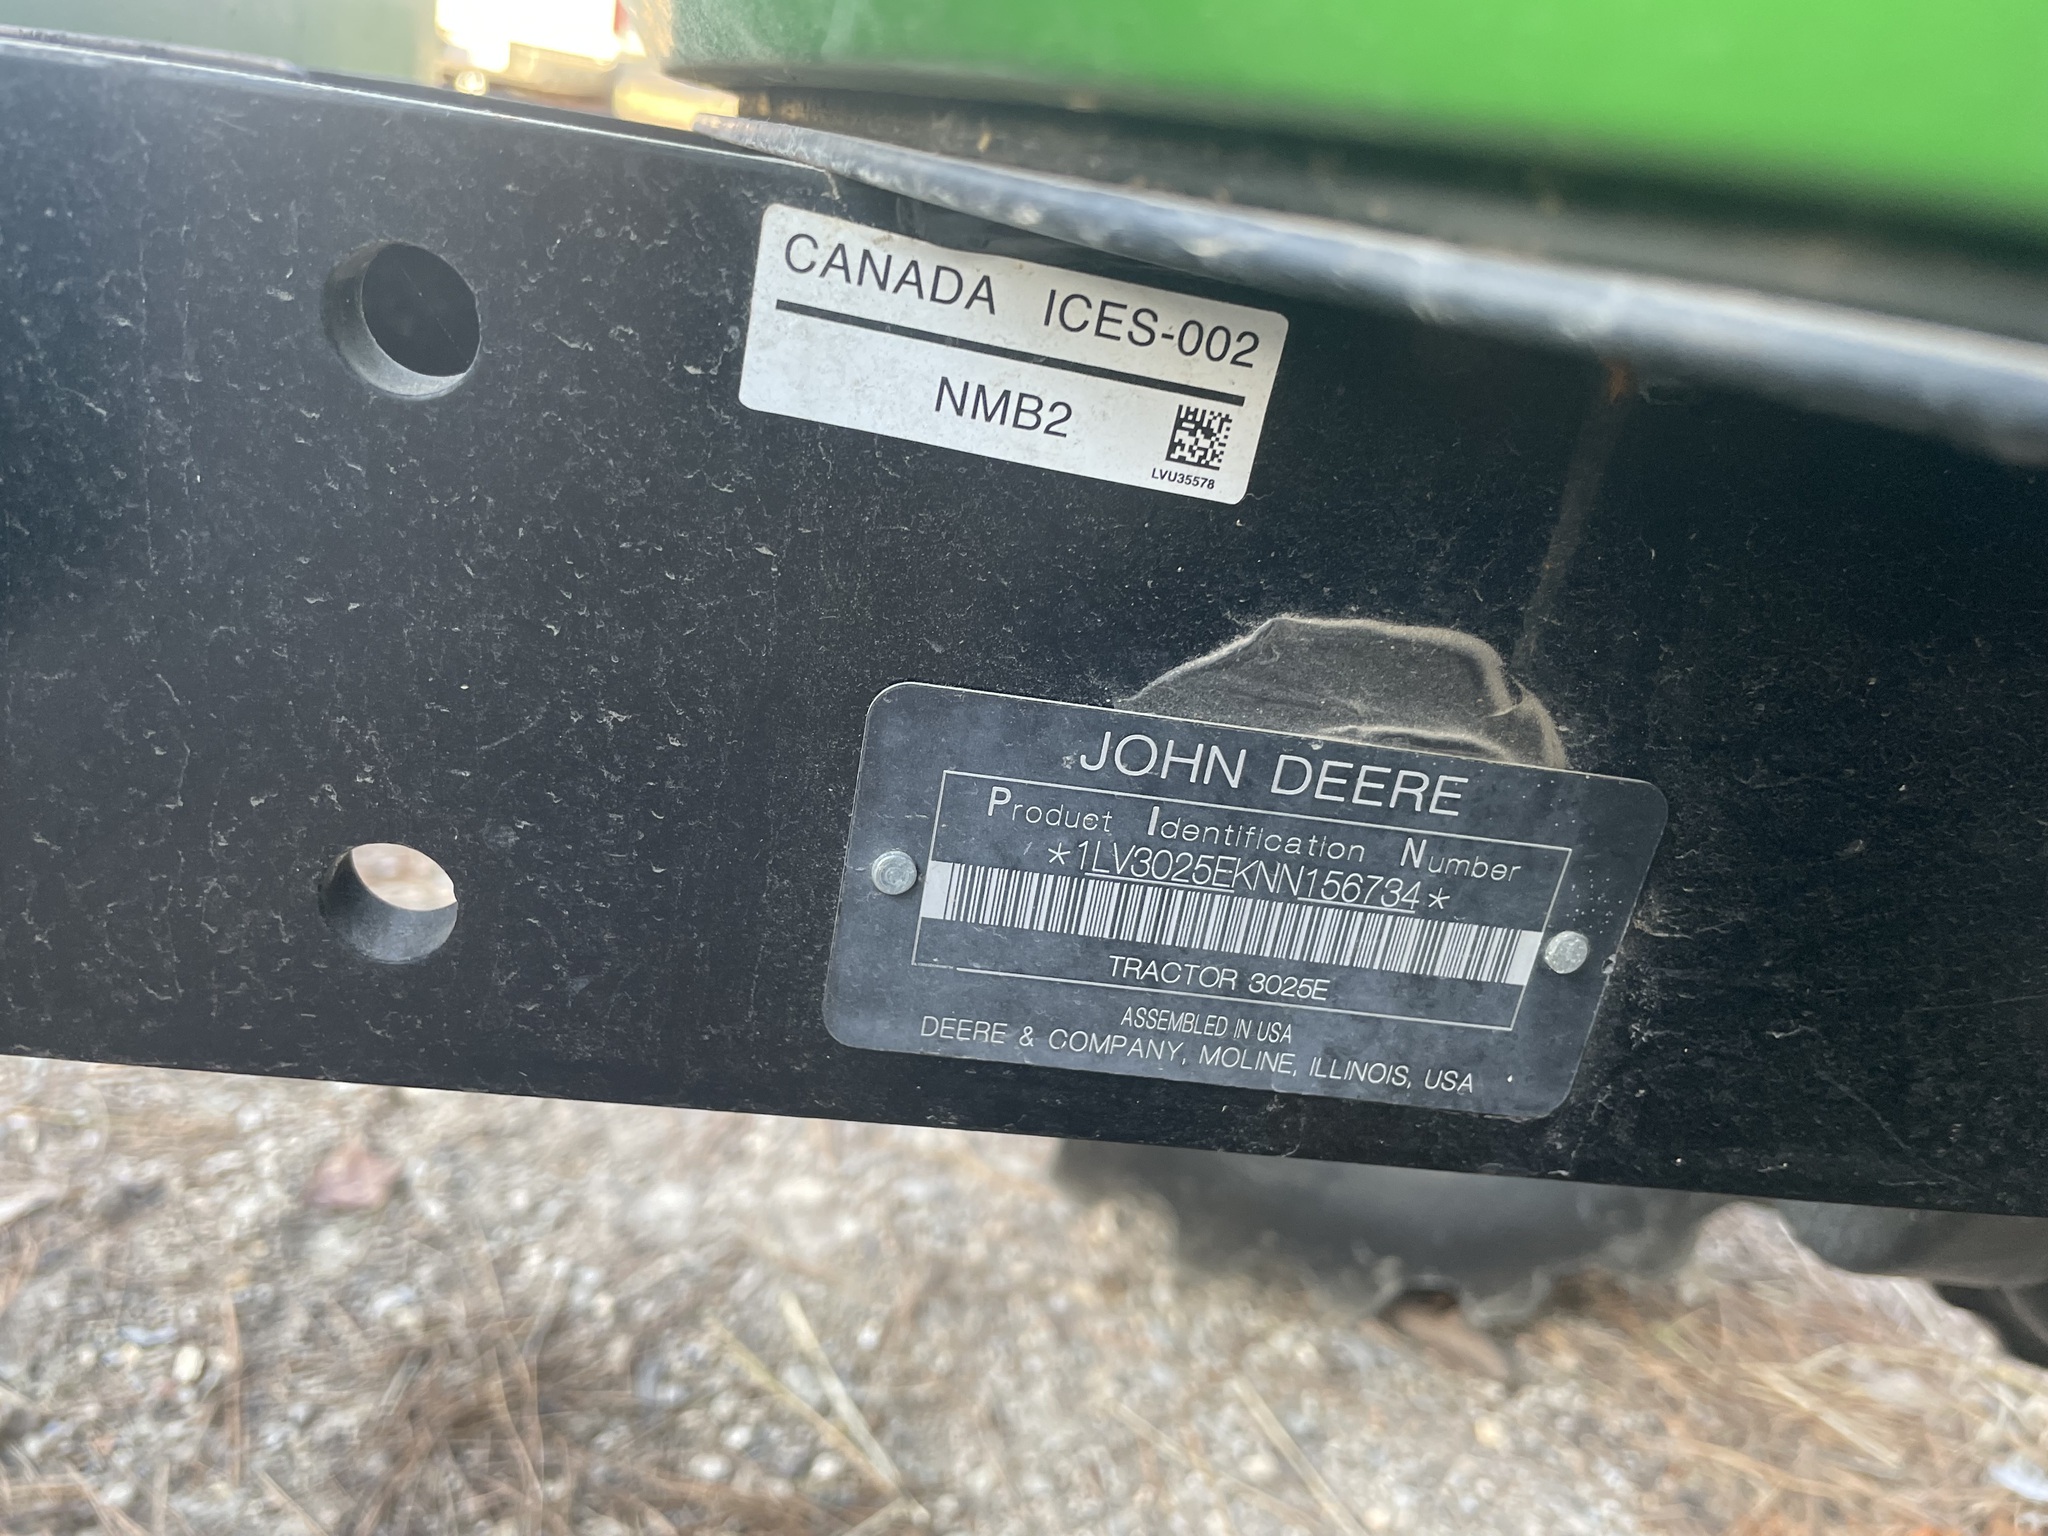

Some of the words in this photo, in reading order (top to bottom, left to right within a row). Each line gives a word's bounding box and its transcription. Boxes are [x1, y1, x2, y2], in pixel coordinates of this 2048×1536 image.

[784, 233, 996, 315] CANADA
[1043, 289, 1260, 369] ICES-002
[934, 376, 1073, 438] NMB2
[1151, 467, 1216, 491] LVU35578
[1080, 731, 1247, 788] JOHN
[1270, 754, 1469, 816] DEERE
[987, 786, 1113, 833] Product
[1147, 805, 1365, 863] Identification
[1400, 838, 1521, 882] Number
[1109, 955, 1238, 990] TRACTOR
[1248, 973, 1331, 1001] 3025E
[920, 1015, 1008, 1044] DEERE
[1019, 1025, 1035, 1047] &
[1048, 1028, 1187, 1065] COMPANY,
[1198, 1044, 1297, 1077] MOLINE,
[1309, 1056, 1412, 1090] ILLINOIS,
[1424, 1069, 1474, 1094] USA
[1120, 1006, 1228, 1037] ASSEMBLED
[1233, 1018, 1252, 1039] IN
[1257, 1021, 1293, 1044] USA
